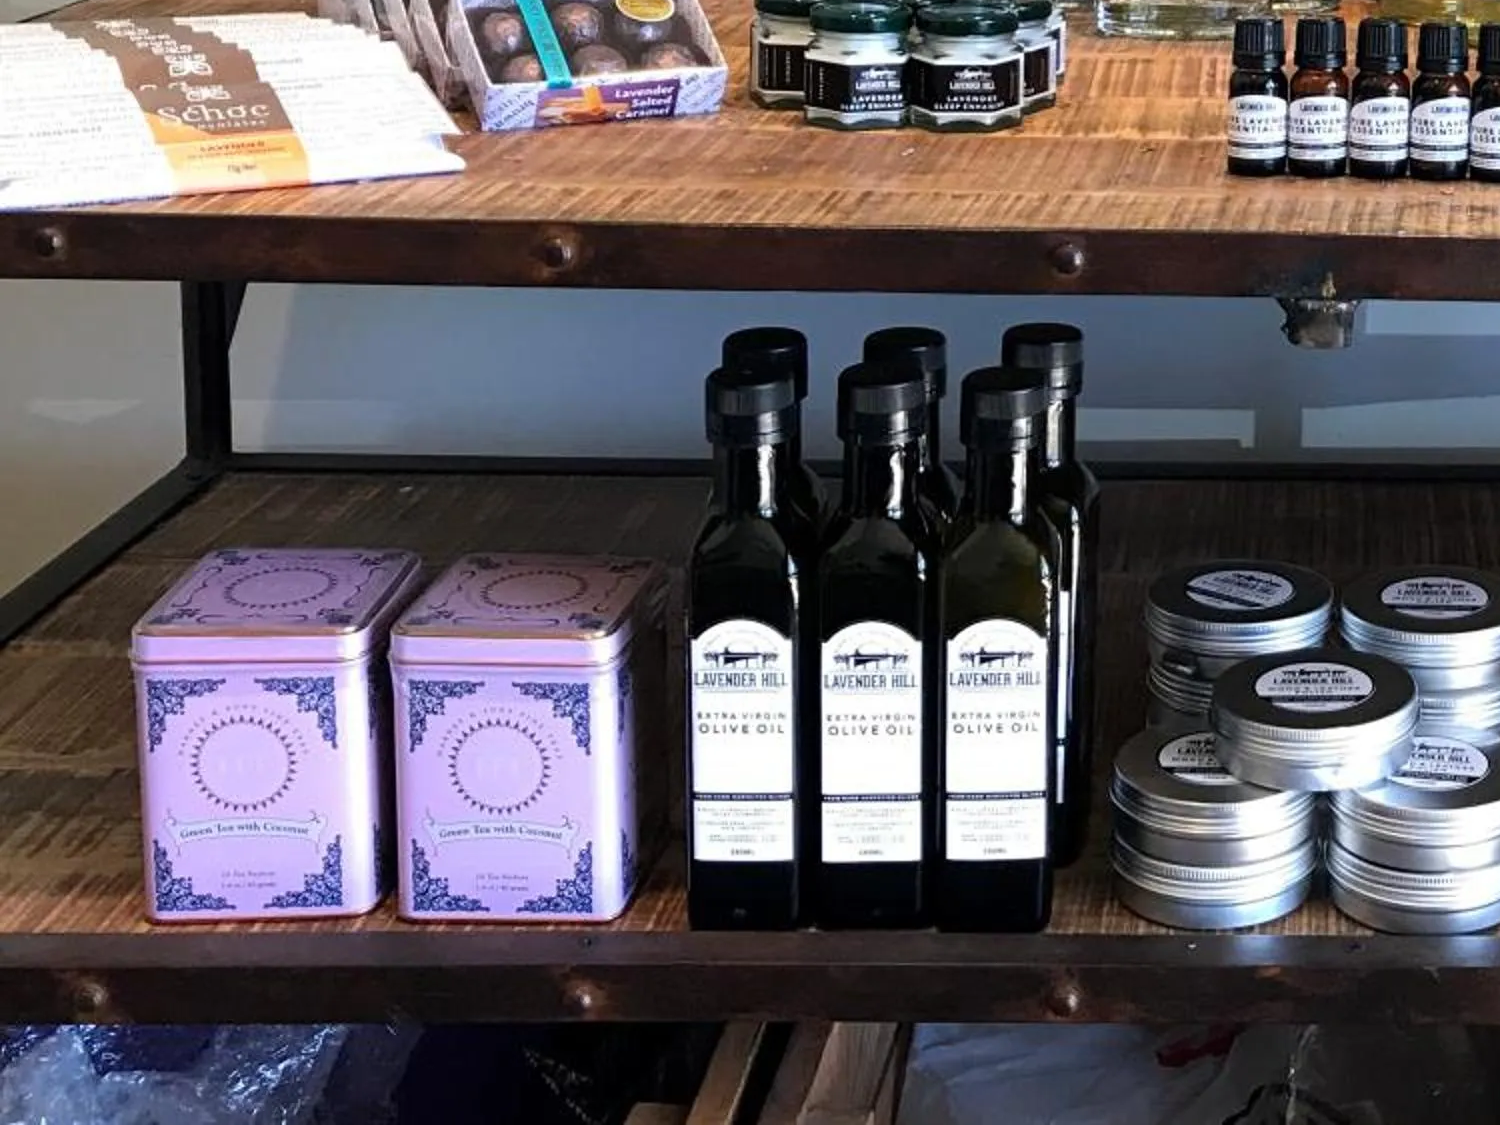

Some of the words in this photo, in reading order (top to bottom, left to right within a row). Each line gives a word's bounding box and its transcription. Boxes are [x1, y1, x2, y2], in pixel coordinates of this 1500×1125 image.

[615, 84, 675, 100] Lavender
[631, 95, 673, 109] Salted
[694, 672, 757, 688] LAVENDER
[761, 672, 788, 688] HILL
[823, 674, 886, 689] LAVENDER
[891, 674, 918, 689] HILL
[949, 672, 1011, 687] LAVENDER
[1016, 671, 1042, 686] HILL
[697, 711, 737, 720] EXTRA
[742, 711, 787, 720] VIRGIN
[826, 713, 866, 722] EXTRA
[872, 713, 915, 722] VIRGIN
[951, 711, 991, 720] EXTRA
[997, 710, 1041, 719] VIRGIN
[699, 723, 749, 735] OLIVE
[756, 723, 785, 735] OIL
[827, 725, 879, 736] OLIVE
[885, 725, 913, 736] OIL
[953, 723, 1004, 734] OLIVE
[1011, 722, 1038, 734] OIL
[180, 827, 213, 839] Green
[214, 823, 234, 833] Tea
[237, 822, 261, 832] with
[263, 823, 309, 835] Coconut
[438, 827, 470, 839] Green
[473, 825, 491, 834] Tea
[493, 824, 516, 834] with
[518, 826, 563, 839] Coconut
